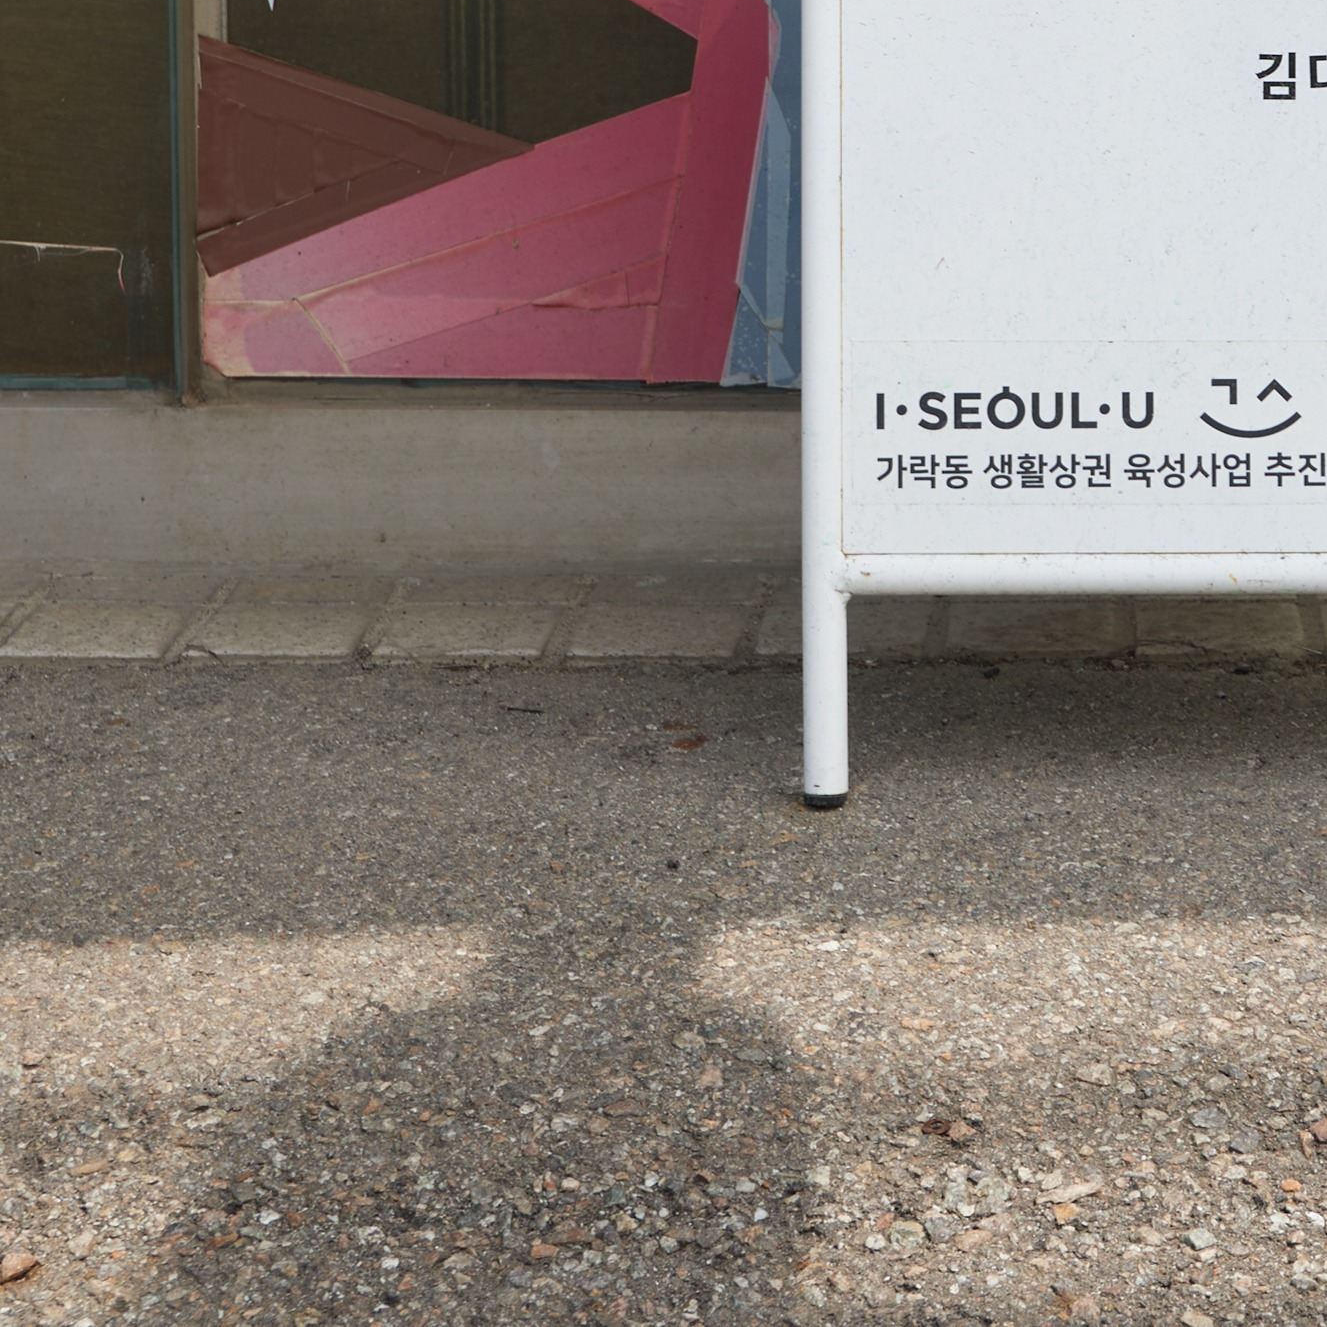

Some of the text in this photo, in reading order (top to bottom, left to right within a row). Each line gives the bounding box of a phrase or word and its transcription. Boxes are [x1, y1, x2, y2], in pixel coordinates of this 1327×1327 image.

[876, 454, 973, 490] 가락동
[983, 453, 1112, 490] 생활상권
[1123, 453, 1252, 489] 육성사업
